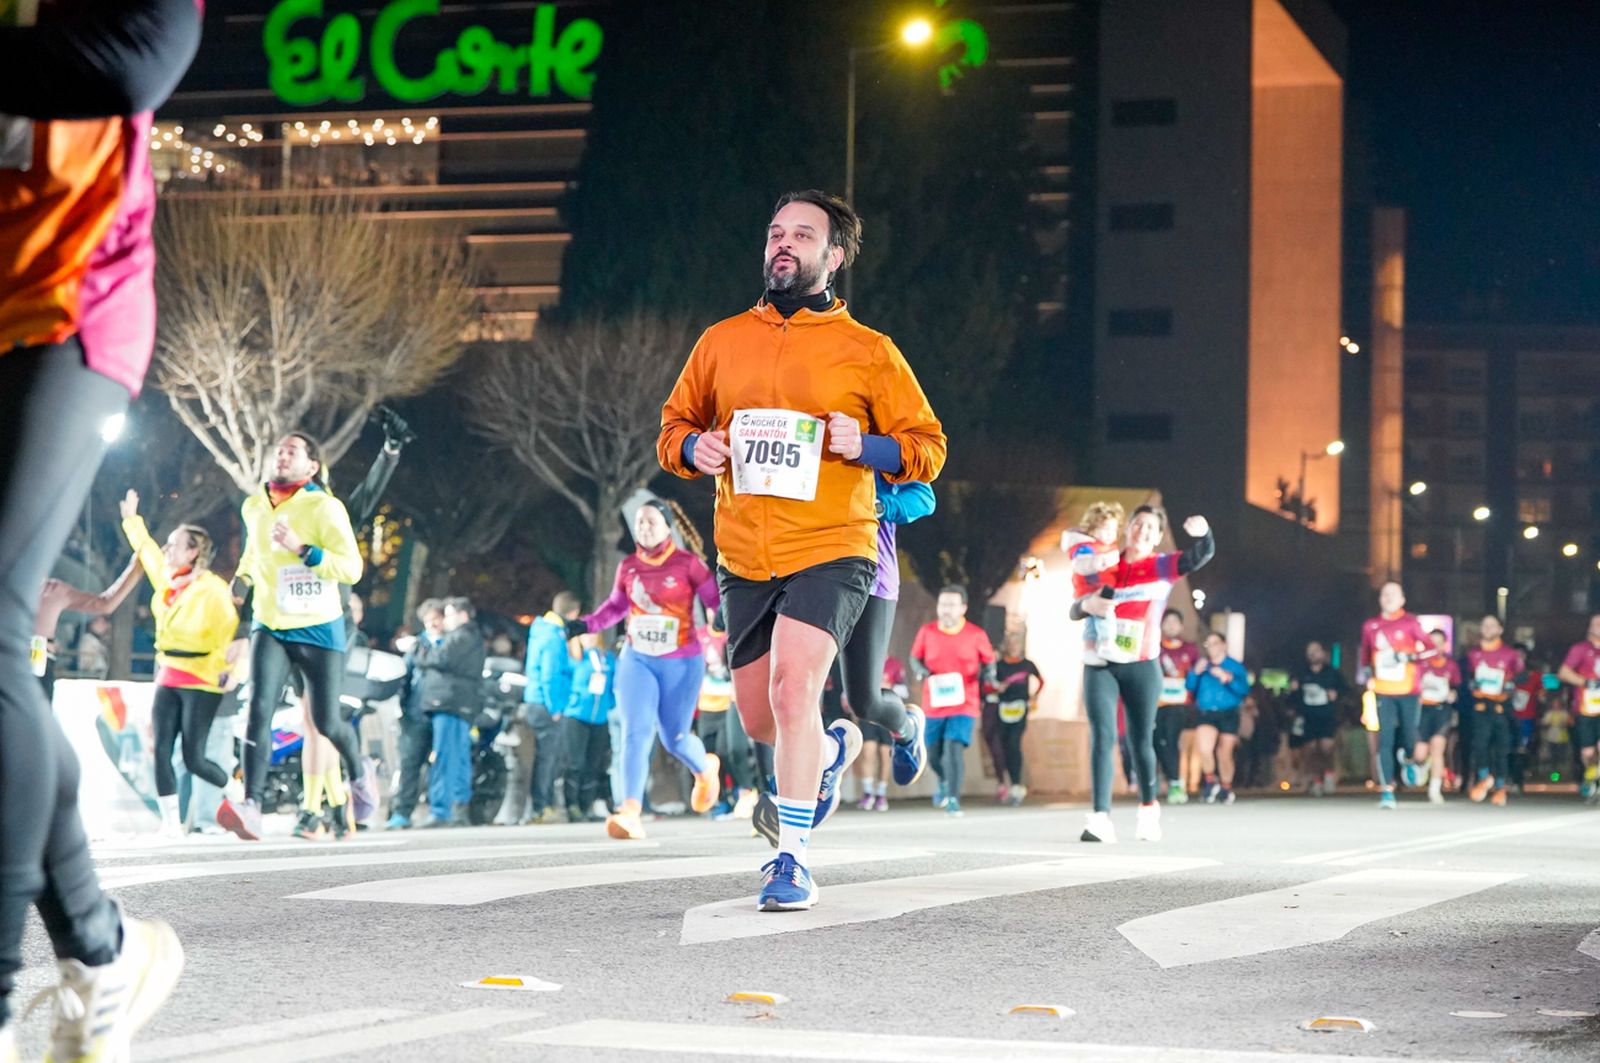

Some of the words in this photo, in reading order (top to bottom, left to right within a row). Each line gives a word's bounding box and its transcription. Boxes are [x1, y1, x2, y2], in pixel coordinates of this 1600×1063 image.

[262, 0, 365, 105] El
[370, 0, 604, 102] Corte
[750, 419, 775, 428] NOCHE
[776, 420, 788, 429] DE
[738, 429, 757, 438] SAN
[745, 440, 801, 468] 7095
[289, 581, 322, 596] 1833
